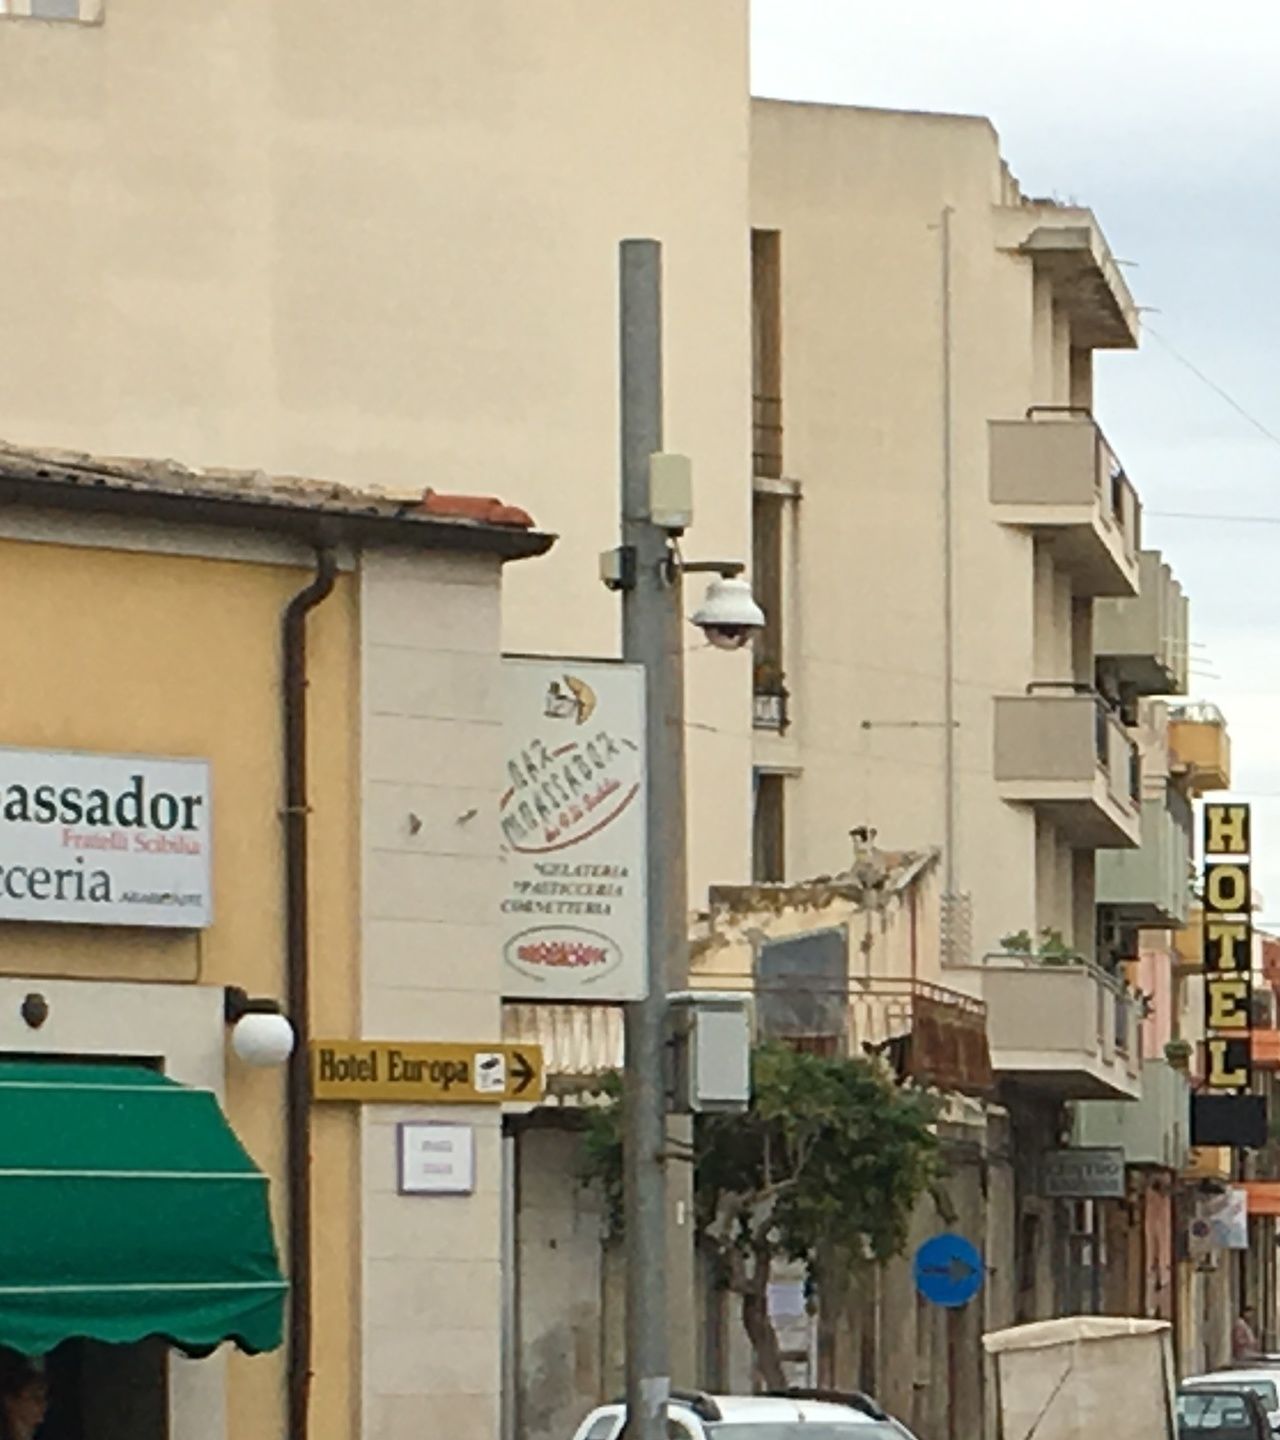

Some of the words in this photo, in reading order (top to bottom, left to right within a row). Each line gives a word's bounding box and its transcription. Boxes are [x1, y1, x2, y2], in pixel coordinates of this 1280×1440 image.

[0, 774, 203, 831] assador
[500, 731, 620, 850] MBASSADOR
[0, 855, 112, 903] ceria
[1208, 806, 1248, 1088] HOTEL
[319, 1049, 379, 1083] Hotel
[387, 1050, 470, 1091] Europa
